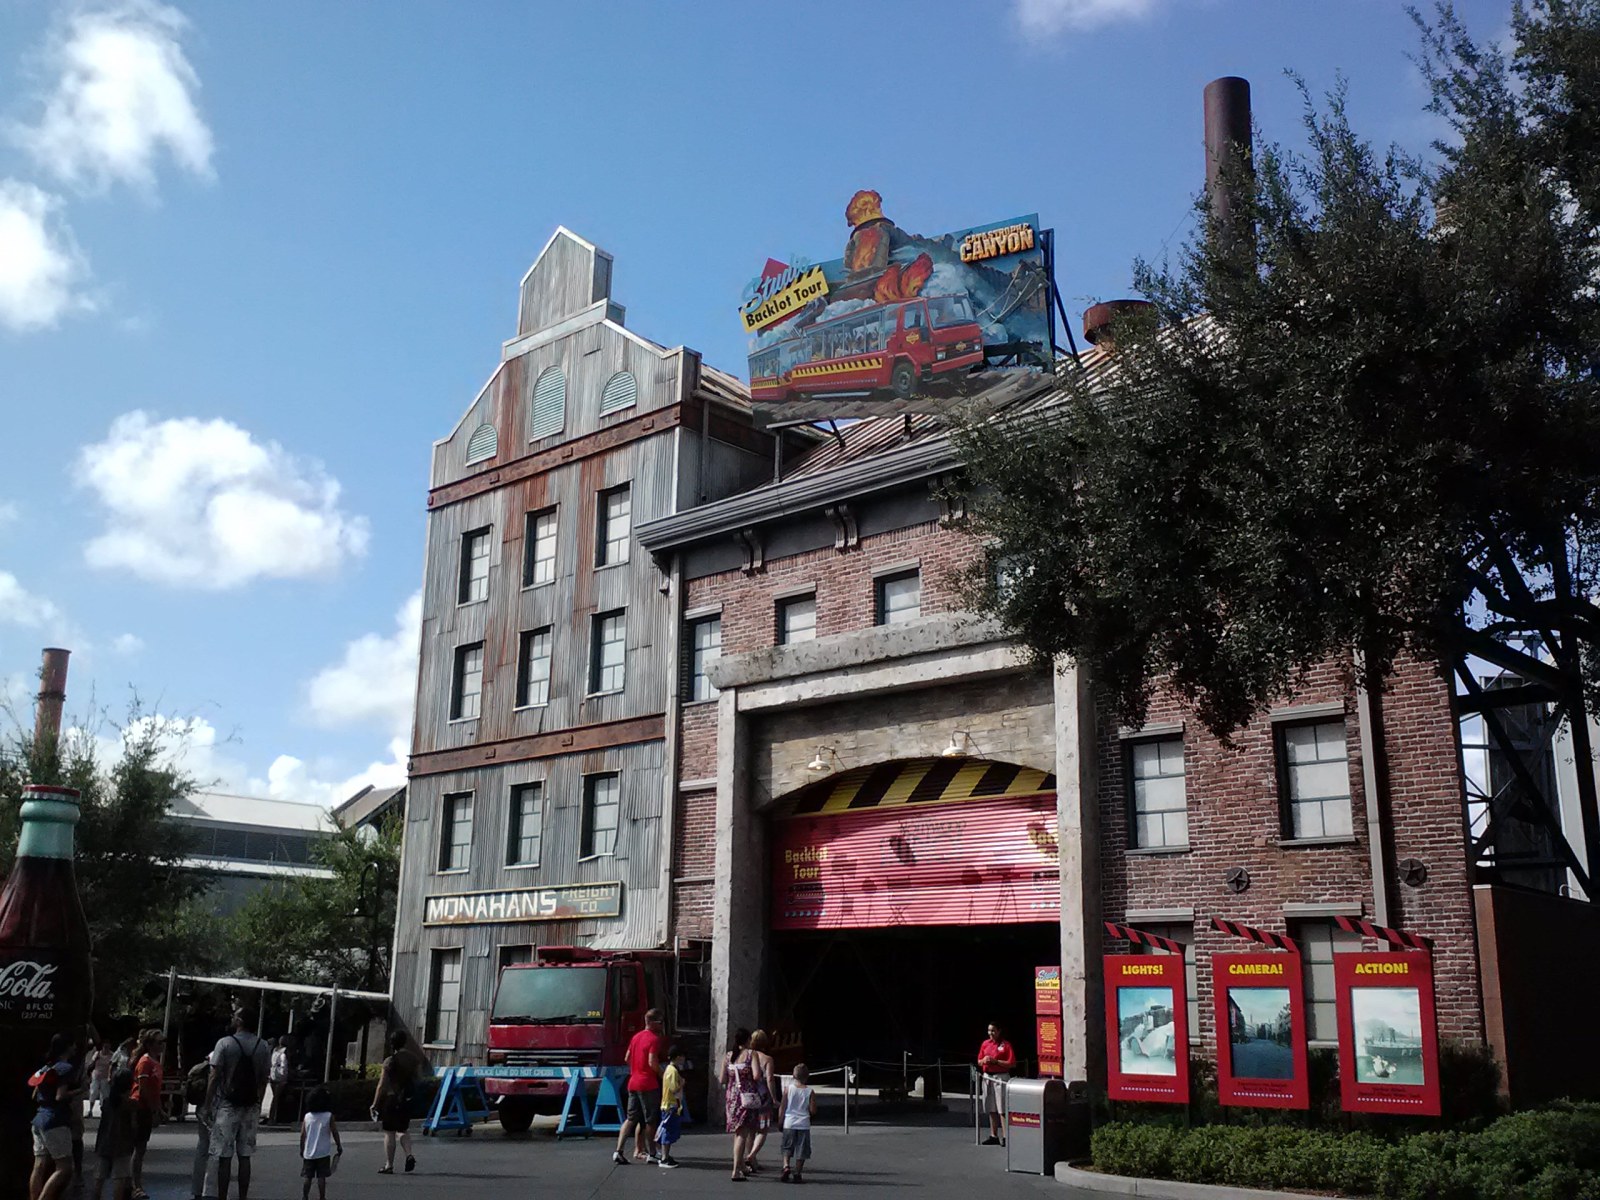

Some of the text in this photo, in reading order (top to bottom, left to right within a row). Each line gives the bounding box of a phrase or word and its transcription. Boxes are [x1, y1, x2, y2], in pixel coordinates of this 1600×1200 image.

[965, 222, 1030, 243] CATASTROPHE
[960, 229, 1035, 262] CANYON
[745, 281, 822, 327] Backlot Tour
[785, 846, 829, 863] Backlot
[793, 864, 820, 879] Tour
[428, 885, 616, 922] MONAHANS FREIGHT
[1122, 964, 1163, 975] LIGHTS!
[1229, 963, 1283, 975] CAMERA!
[1355, 962, 1409, 975] ACTION!
[473, 1068, 554, 1076] POLICE LINE DO NOT CROSS
